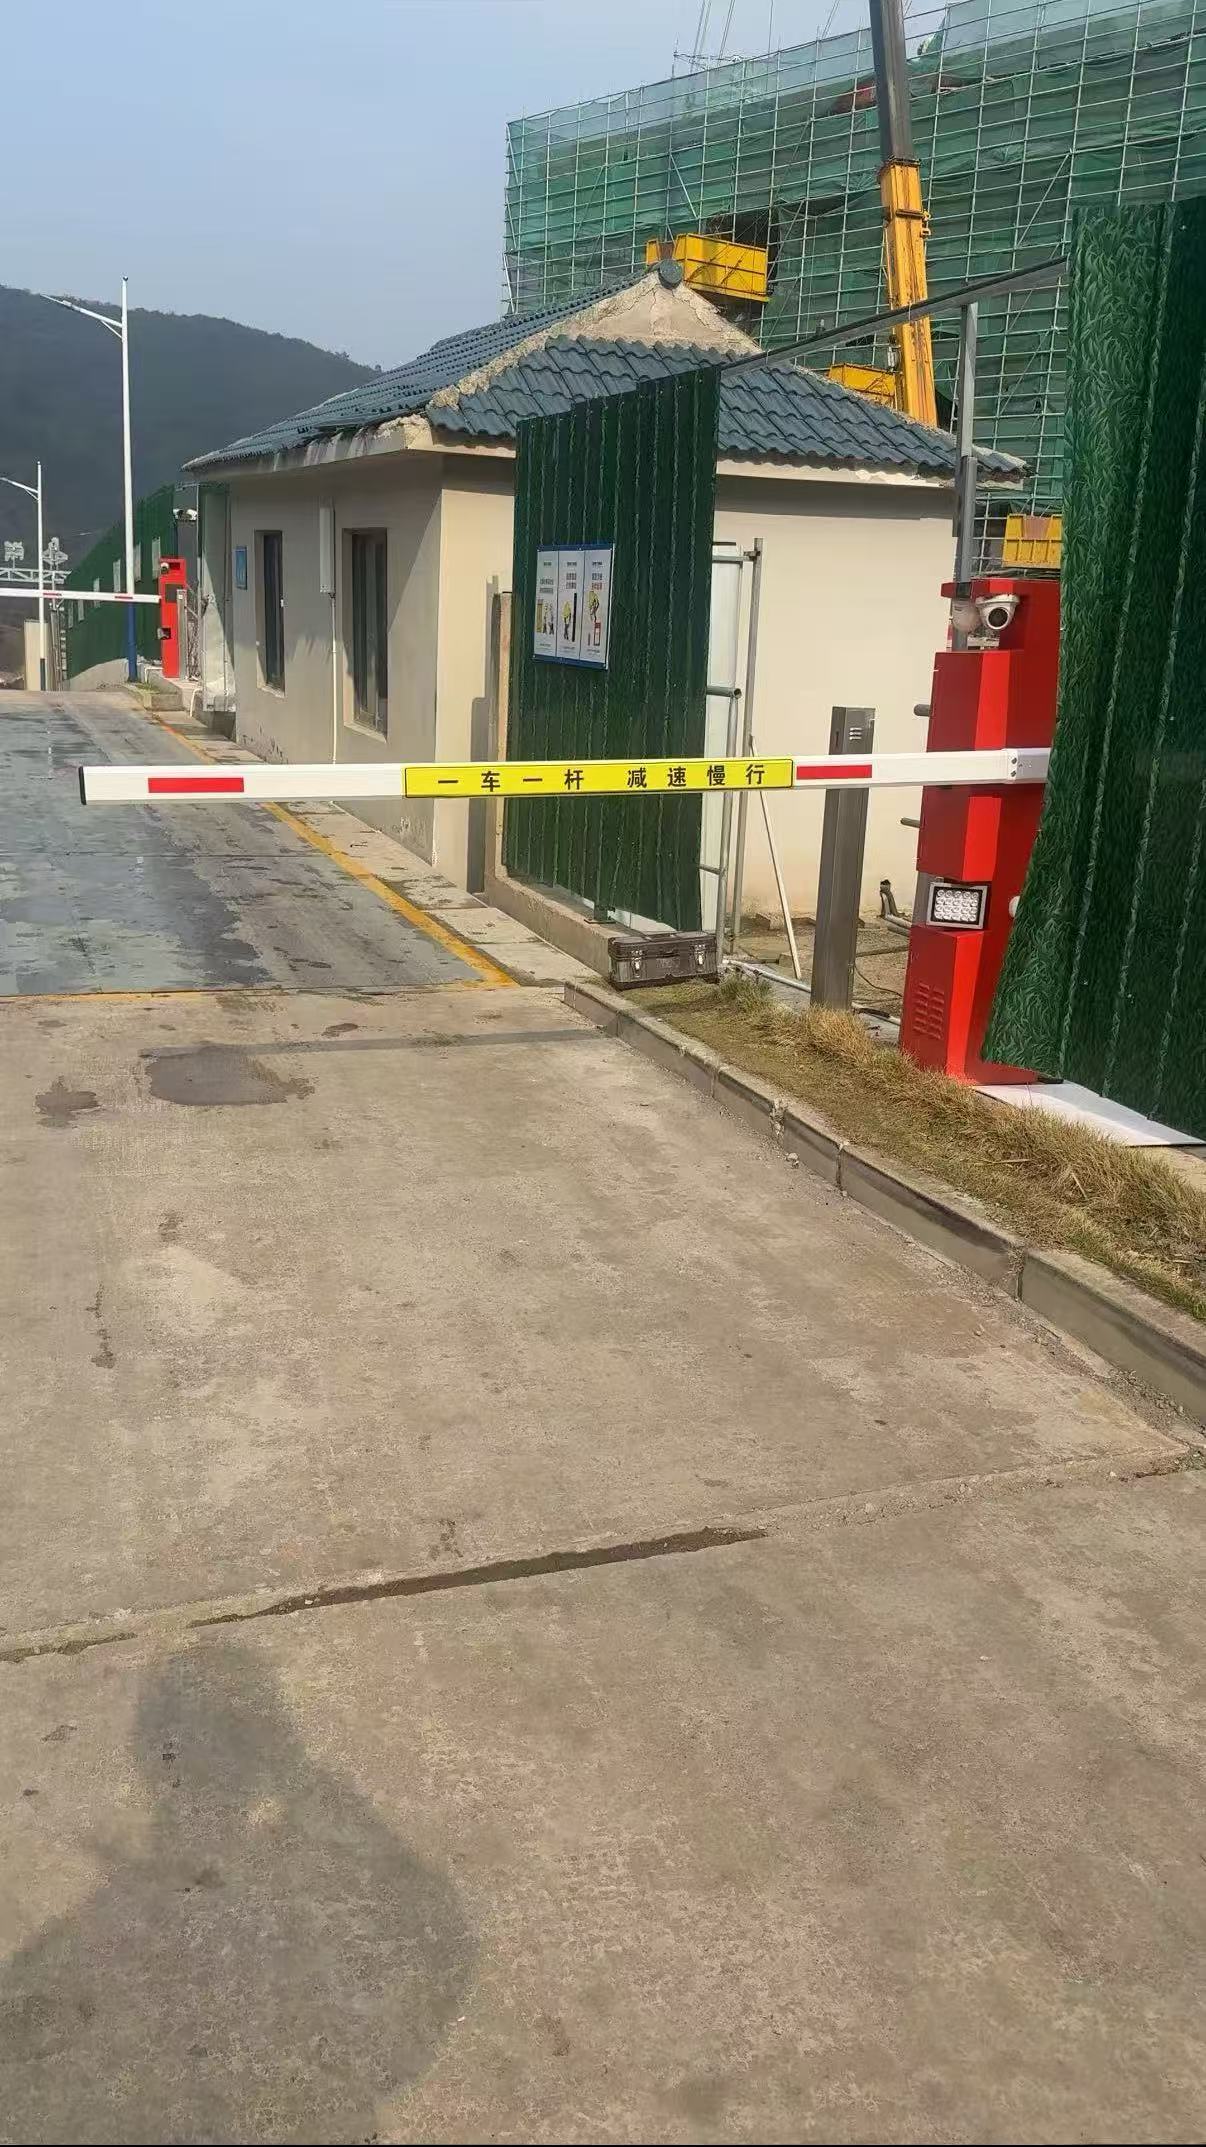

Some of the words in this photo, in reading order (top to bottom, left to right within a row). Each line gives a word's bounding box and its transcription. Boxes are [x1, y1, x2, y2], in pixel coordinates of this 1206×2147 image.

[438, 768, 584, 792] 一车一杆
[627, 764, 766, 789] 减速慢行
